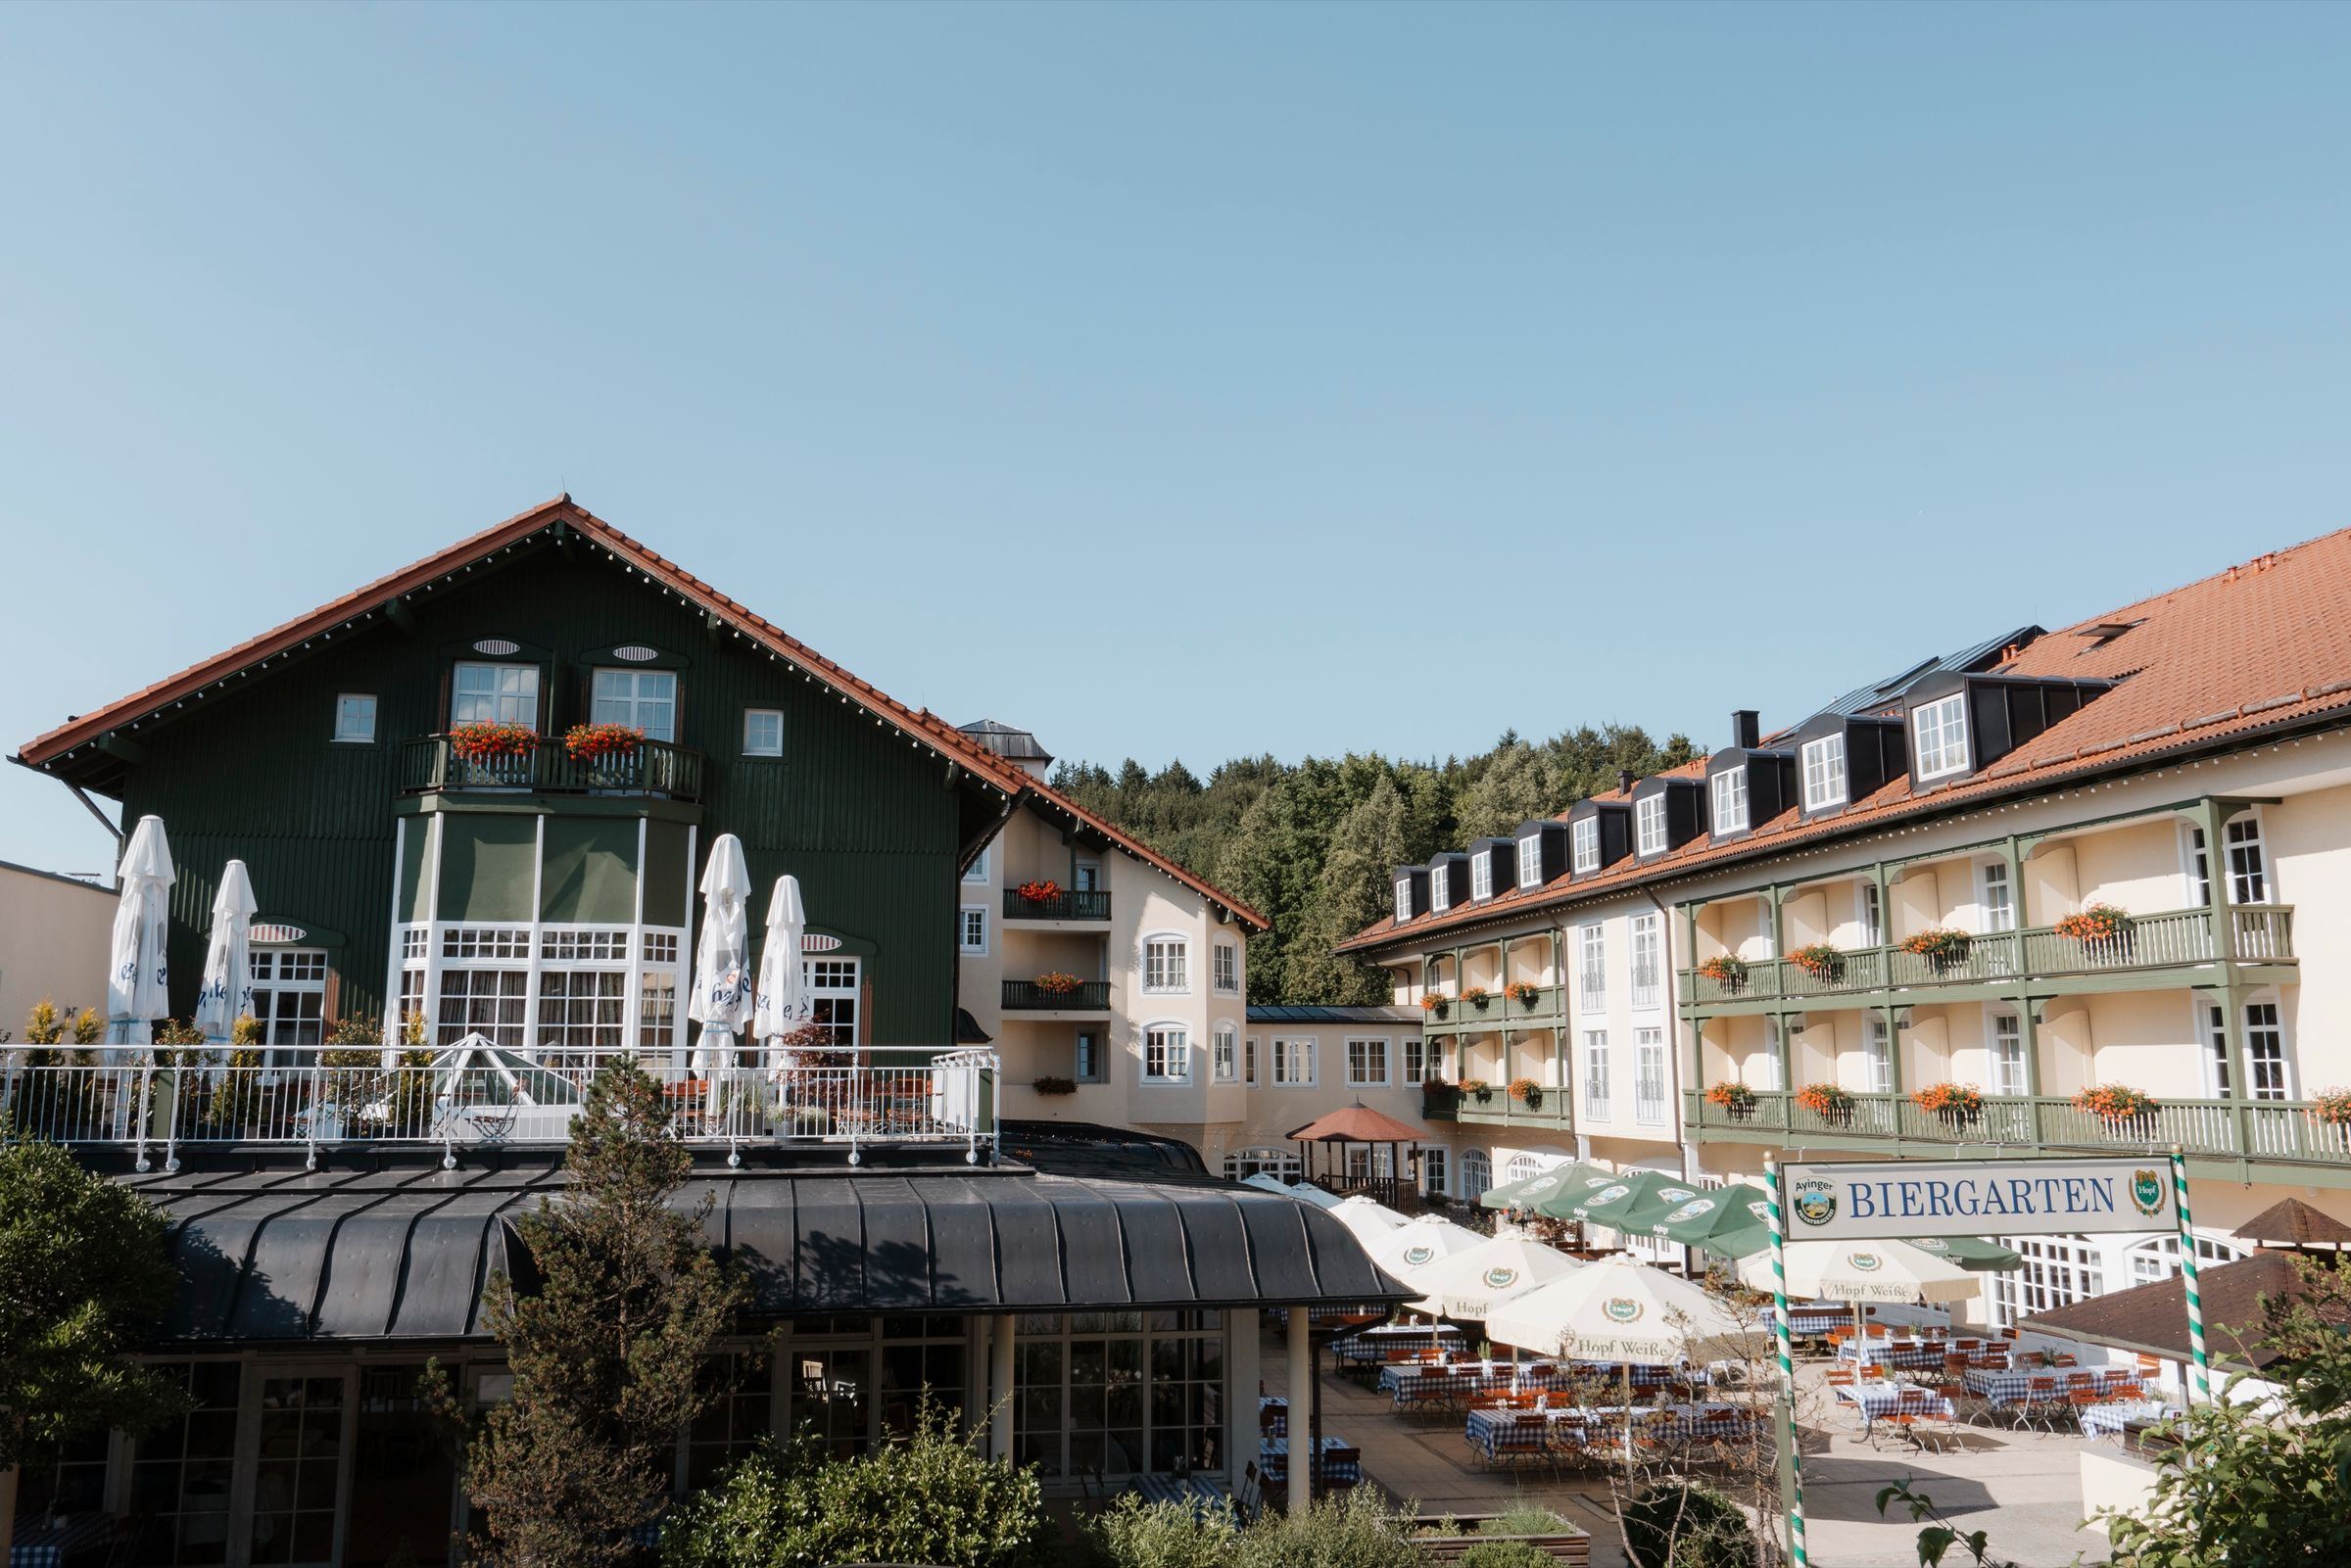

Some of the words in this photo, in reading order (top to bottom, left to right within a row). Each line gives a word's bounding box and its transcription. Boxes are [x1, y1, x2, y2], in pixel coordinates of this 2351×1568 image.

[1796, 1179, 1833, 1191] Ayinger
[2138, 1186, 2156, 1196] Hopf
[1847, 1178, 2114, 1218] BIERGARTEN
[1833, 1284, 1866, 1298] Hopf
[1870, 1284, 1909, 1298] Weiße
[1457, 1302, 1489, 1316] Hopf
[1578, 1339, 1616, 1356] Hopf
[1621, 1341, 1667, 1357] Weiße
